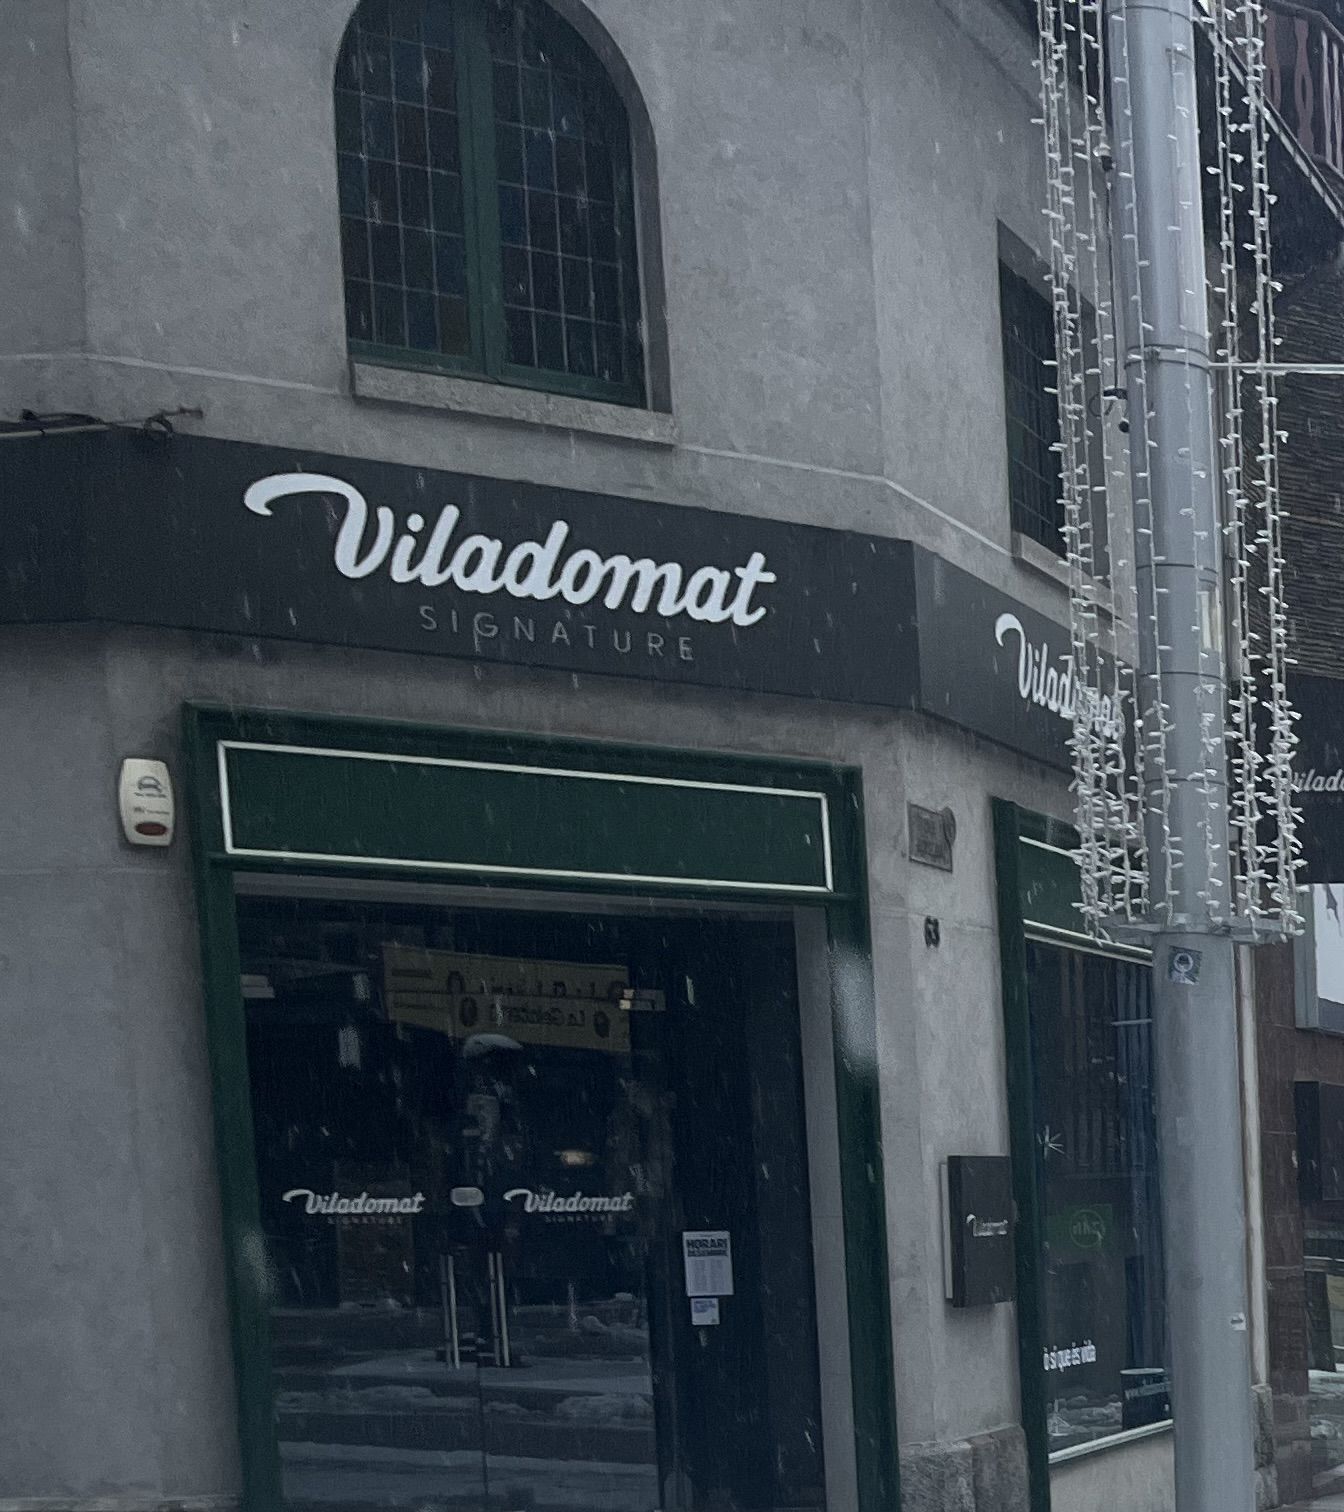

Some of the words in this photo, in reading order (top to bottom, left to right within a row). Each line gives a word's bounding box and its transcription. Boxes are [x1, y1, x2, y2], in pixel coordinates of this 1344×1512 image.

[243, 473, 777, 627] Viladomat
[418, 604, 696, 662] SIGNATURE
[282, 1187, 425, 1214] Viladomat
[504, 1187, 634, 1214] Viladomat
